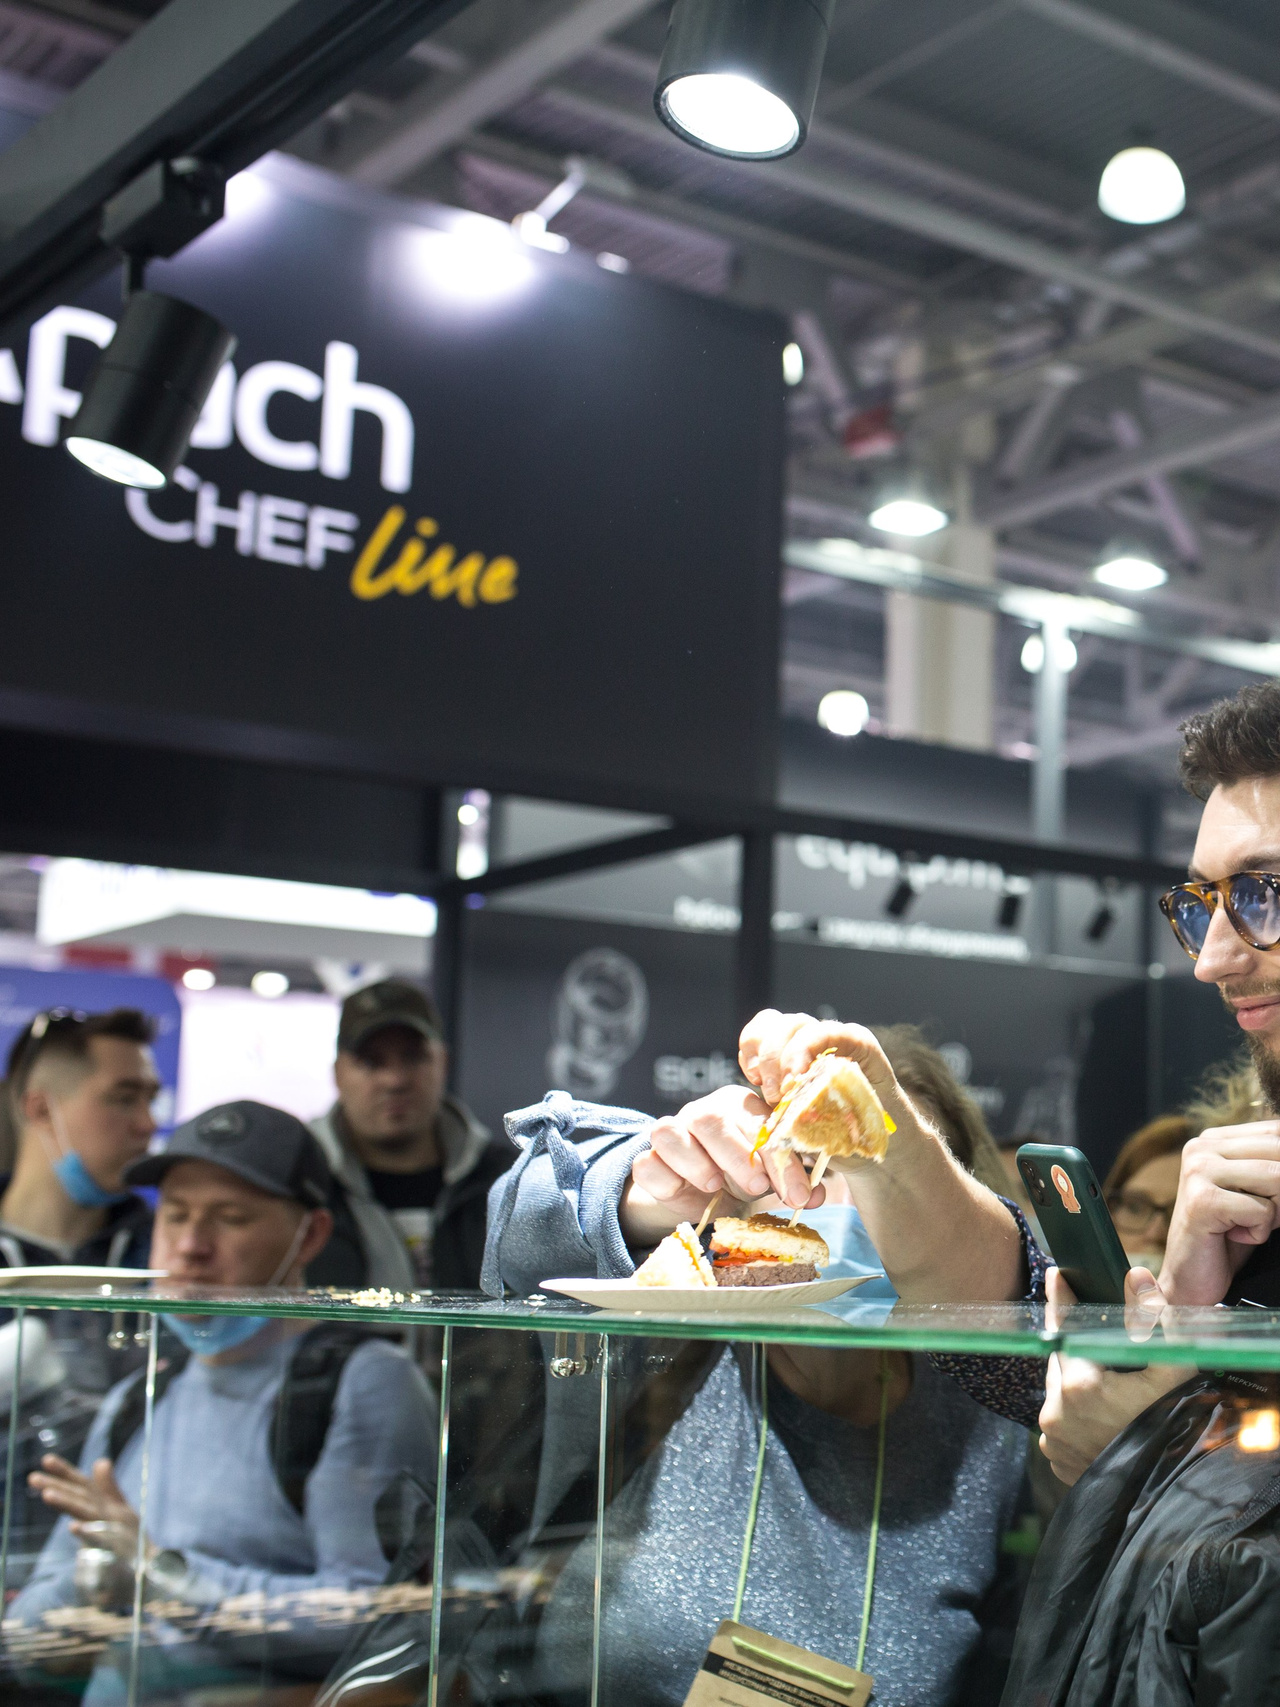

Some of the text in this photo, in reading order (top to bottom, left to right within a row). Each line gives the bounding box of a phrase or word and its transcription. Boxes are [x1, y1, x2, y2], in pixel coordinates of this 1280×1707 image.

[0, 305, 415, 493] pch
[126, 464, 518, 608] CHEF line
[1228, 1375, 1268, 1393] МЕРКУРИЙ
